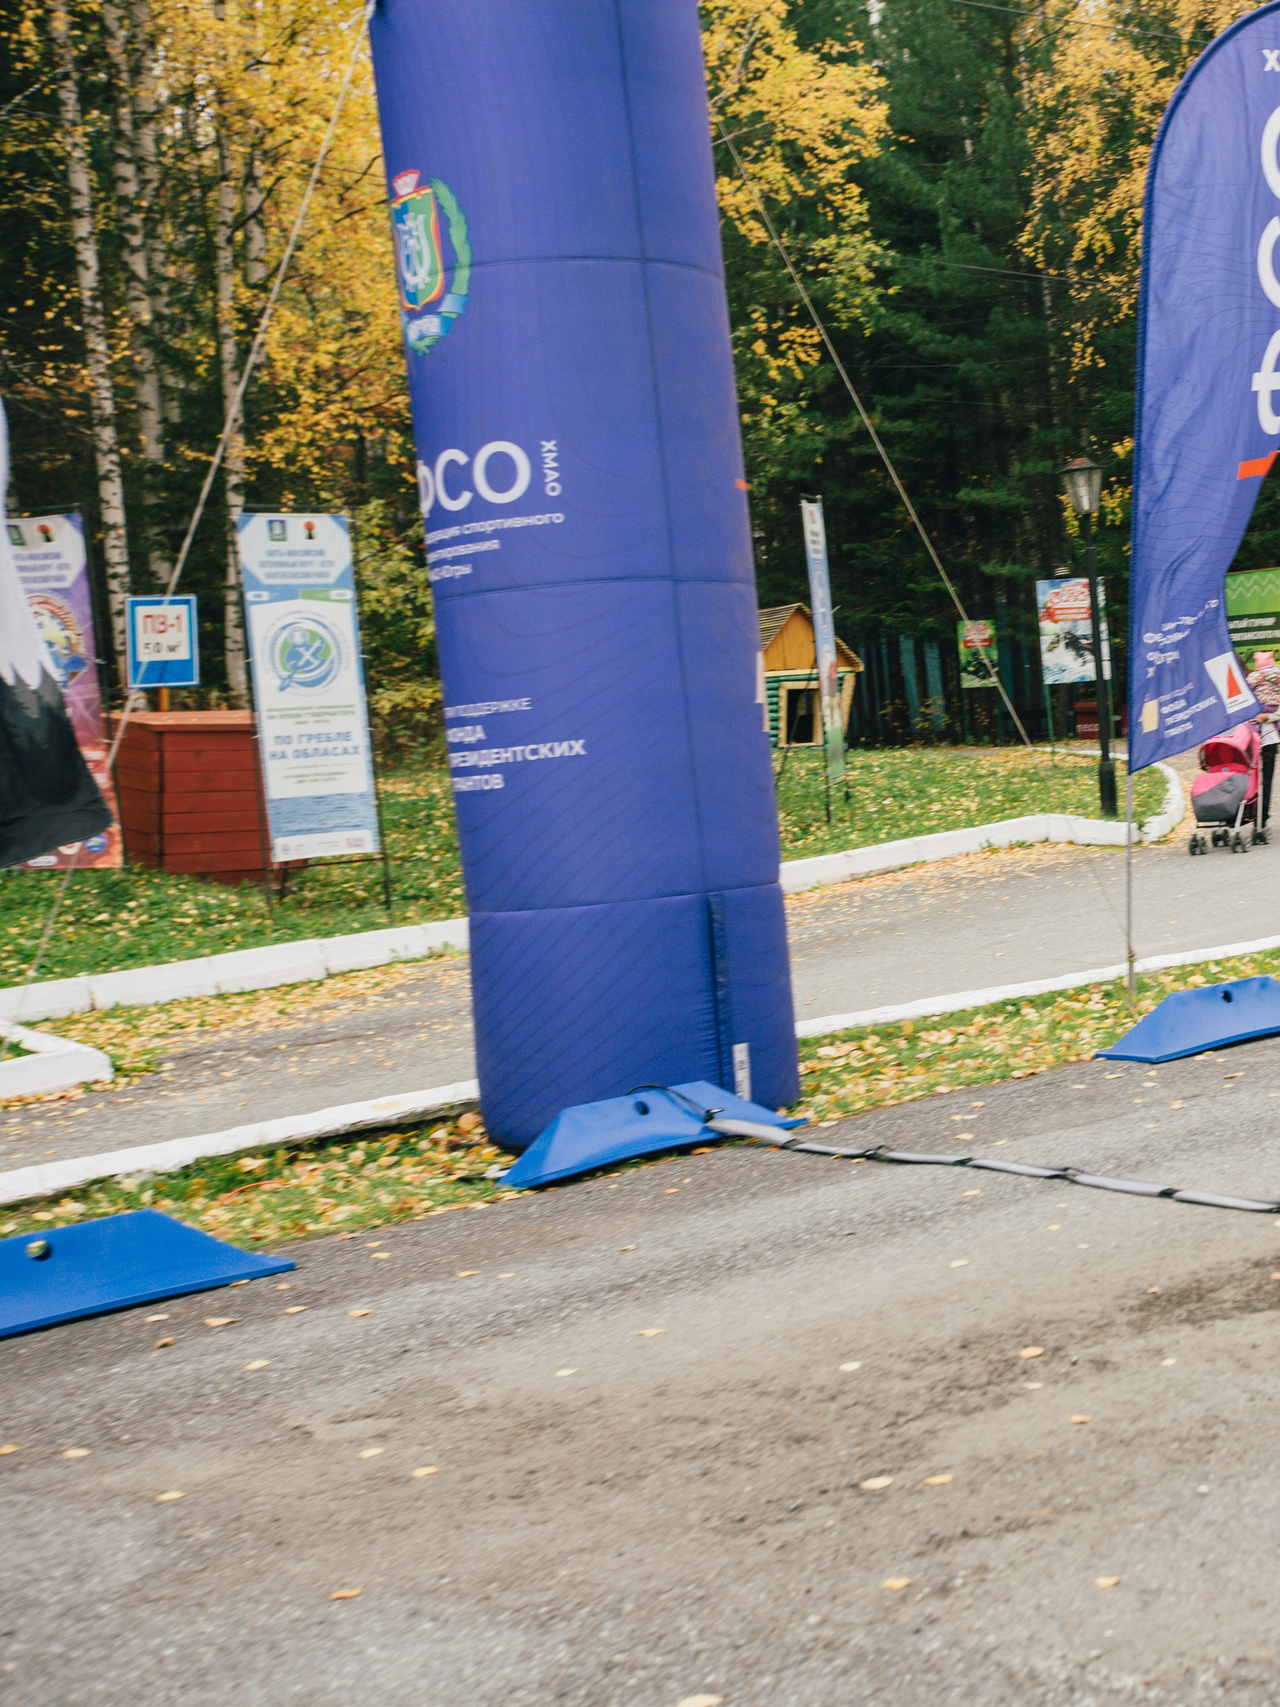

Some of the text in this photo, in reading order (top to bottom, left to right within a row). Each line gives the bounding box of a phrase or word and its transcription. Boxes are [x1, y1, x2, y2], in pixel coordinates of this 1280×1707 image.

[540, 440, 562, 496] ХМАО
[462, 512, 565, 534] спортивного
[298, 731, 352, 744] ГРЕБЛЕ
[292, 745, 360, 759] ОБЛАСАХ
